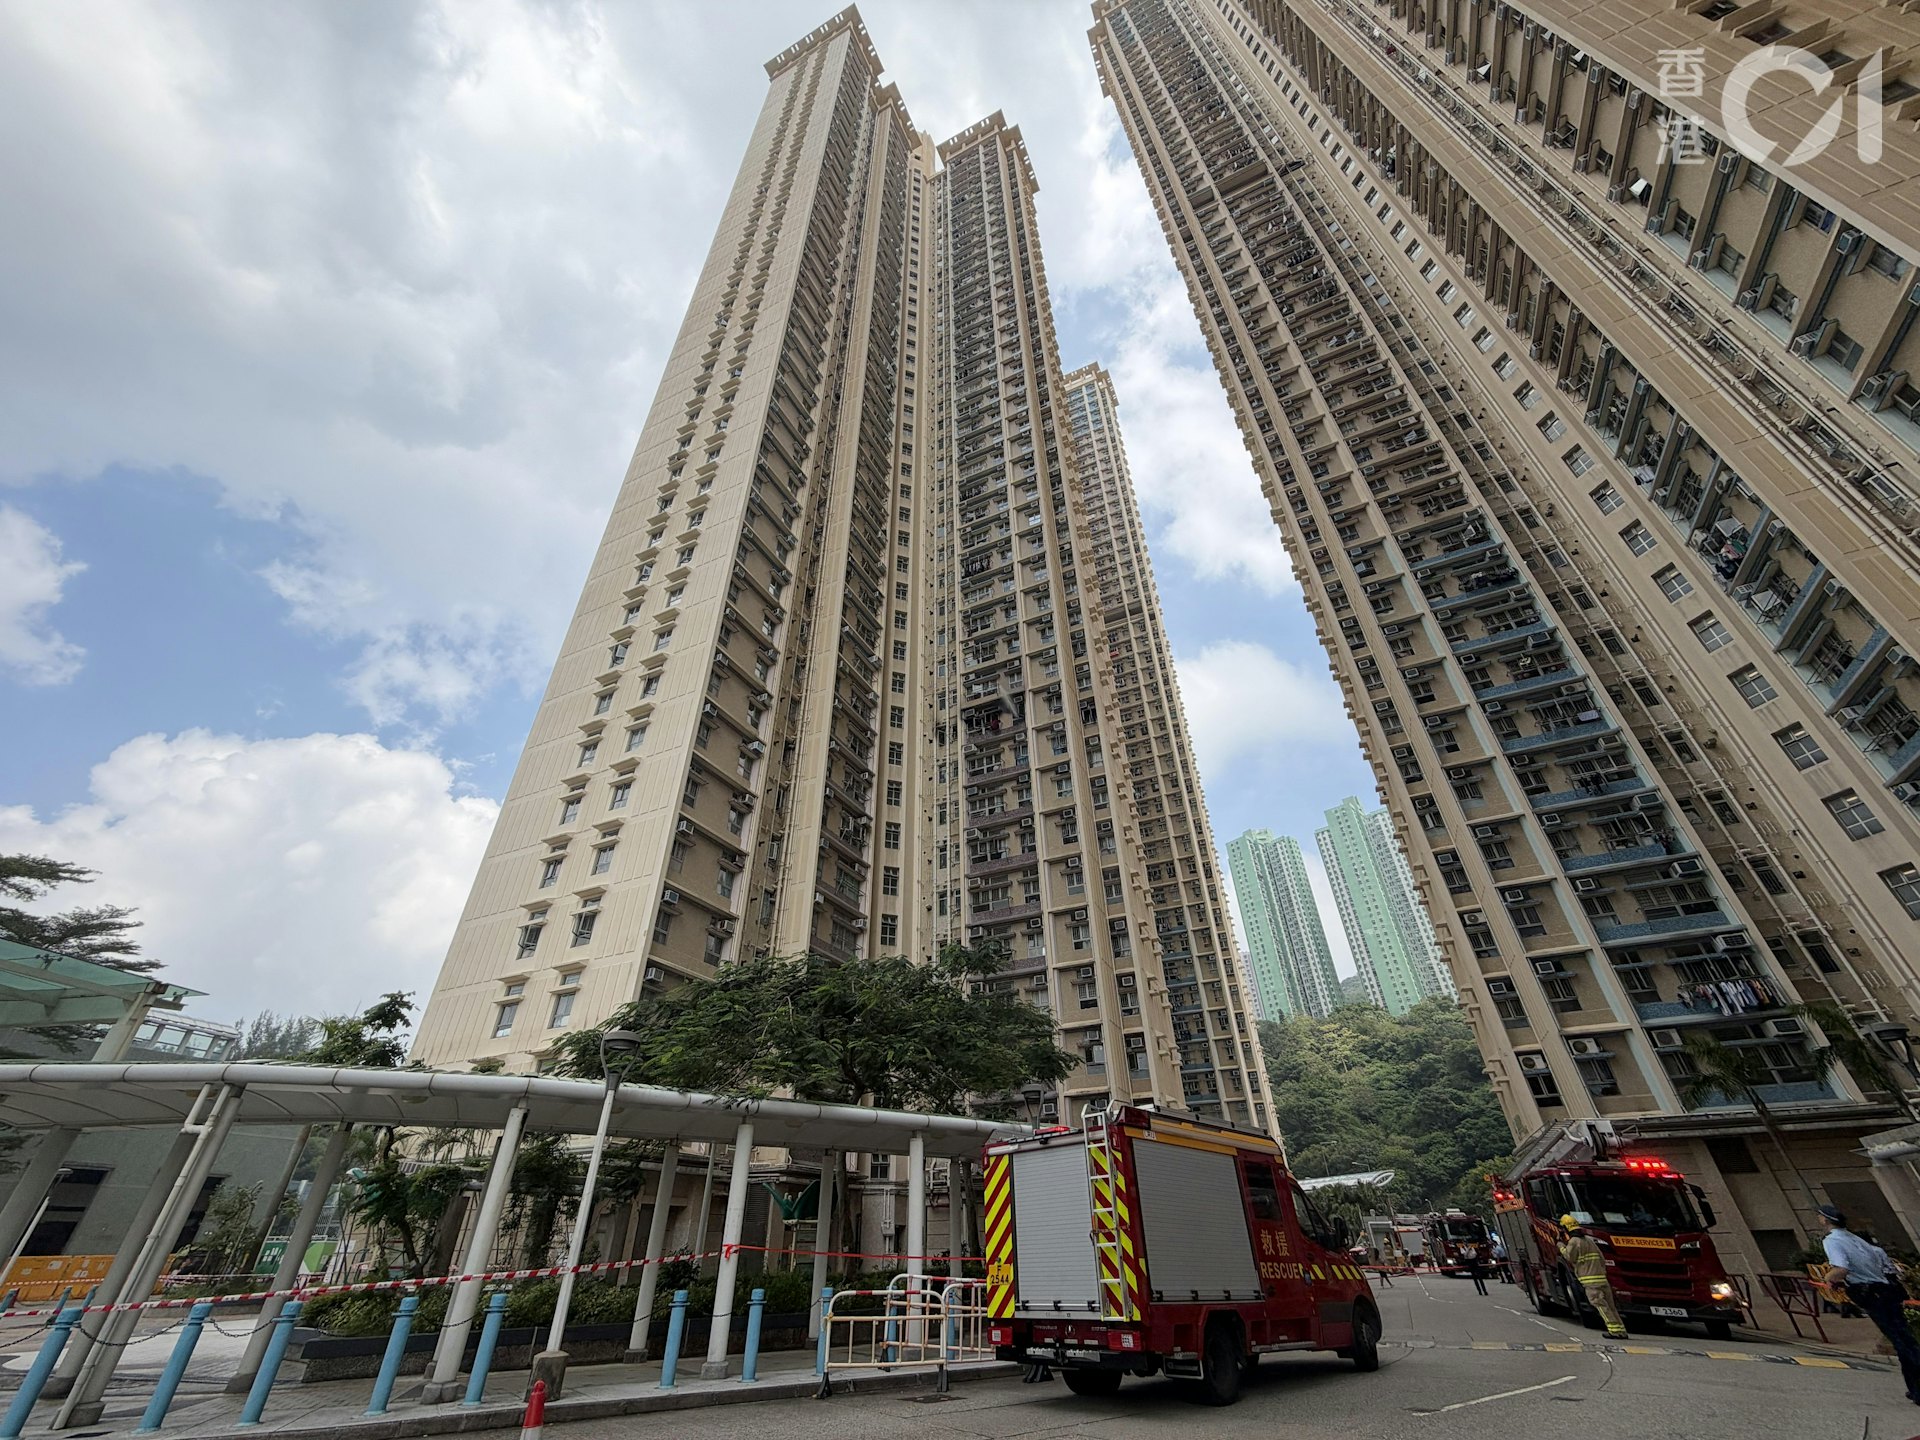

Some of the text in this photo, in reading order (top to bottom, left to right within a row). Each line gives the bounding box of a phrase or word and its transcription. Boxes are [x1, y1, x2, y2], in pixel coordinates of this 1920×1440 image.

[1260, 1229, 1290, 1256] 救援
[996, 1265, 1002, 1275] F
[1260, 1262, 1300, 1279] RESCUE
[990, 1274, 1010, 1284] 2544
